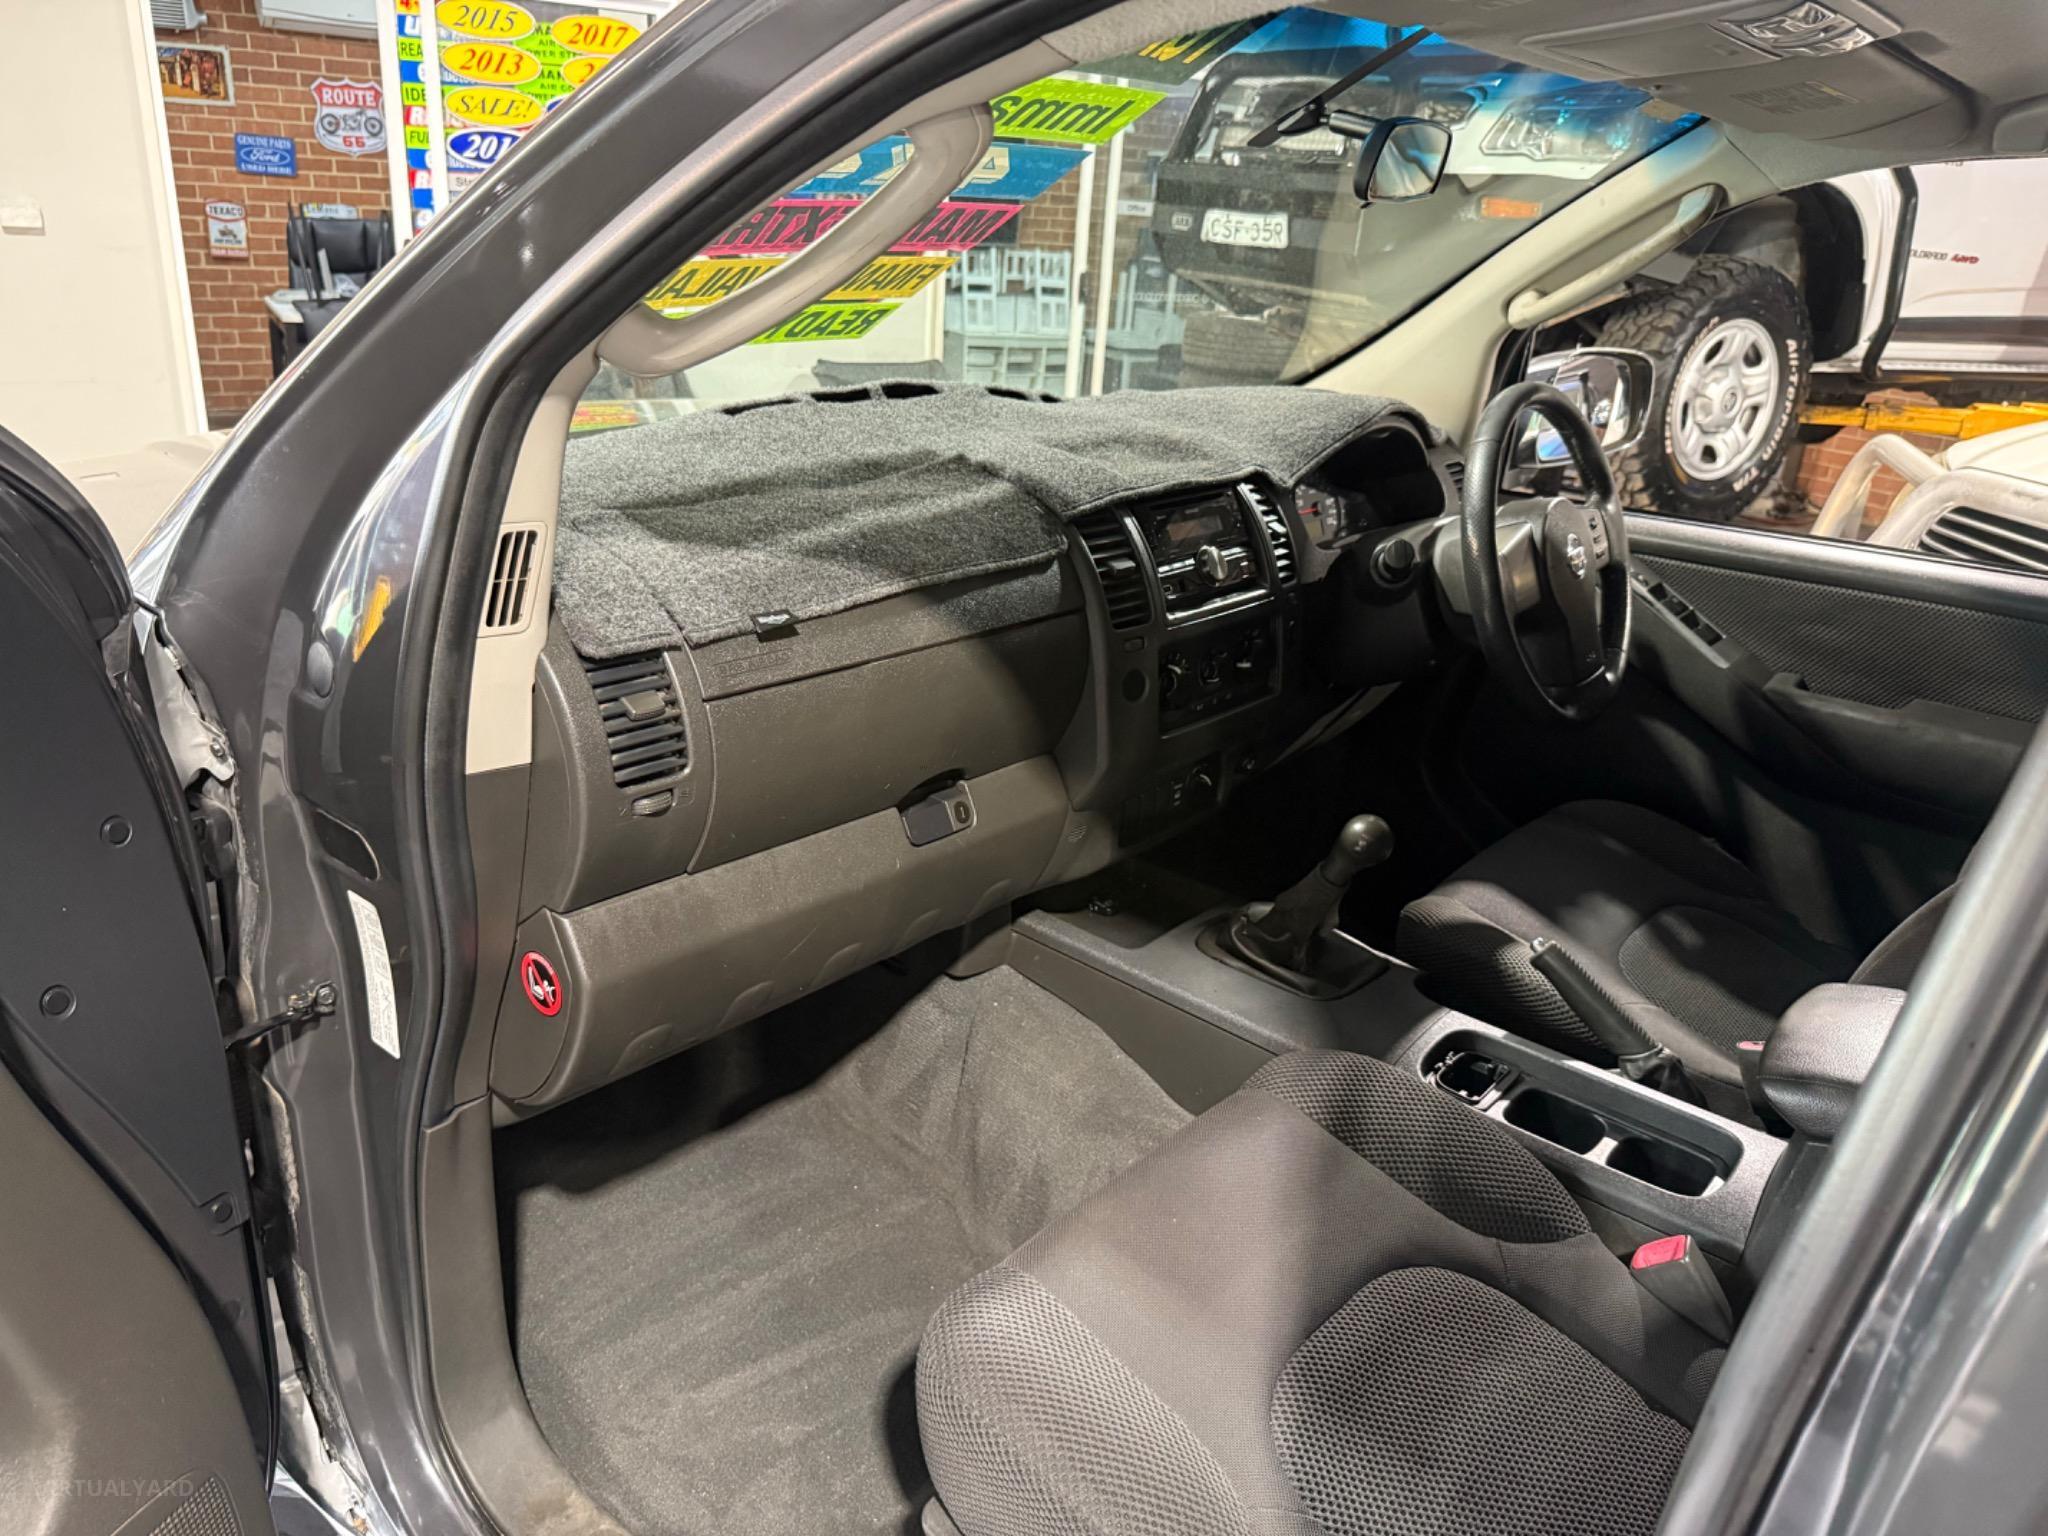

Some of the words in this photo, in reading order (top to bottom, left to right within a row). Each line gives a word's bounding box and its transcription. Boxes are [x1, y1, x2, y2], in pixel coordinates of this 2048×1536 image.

[453, 5, 518, 32] 2015
[567, 22, 629, 48] 2017
[459, 48, 524, 76] 2013
[322, 88, 377, 107] ROUTE
[454, 95, 534, 119] SALE!
[343, 136, 366, 148] 66
[250, 149, 281, 163] Ford
